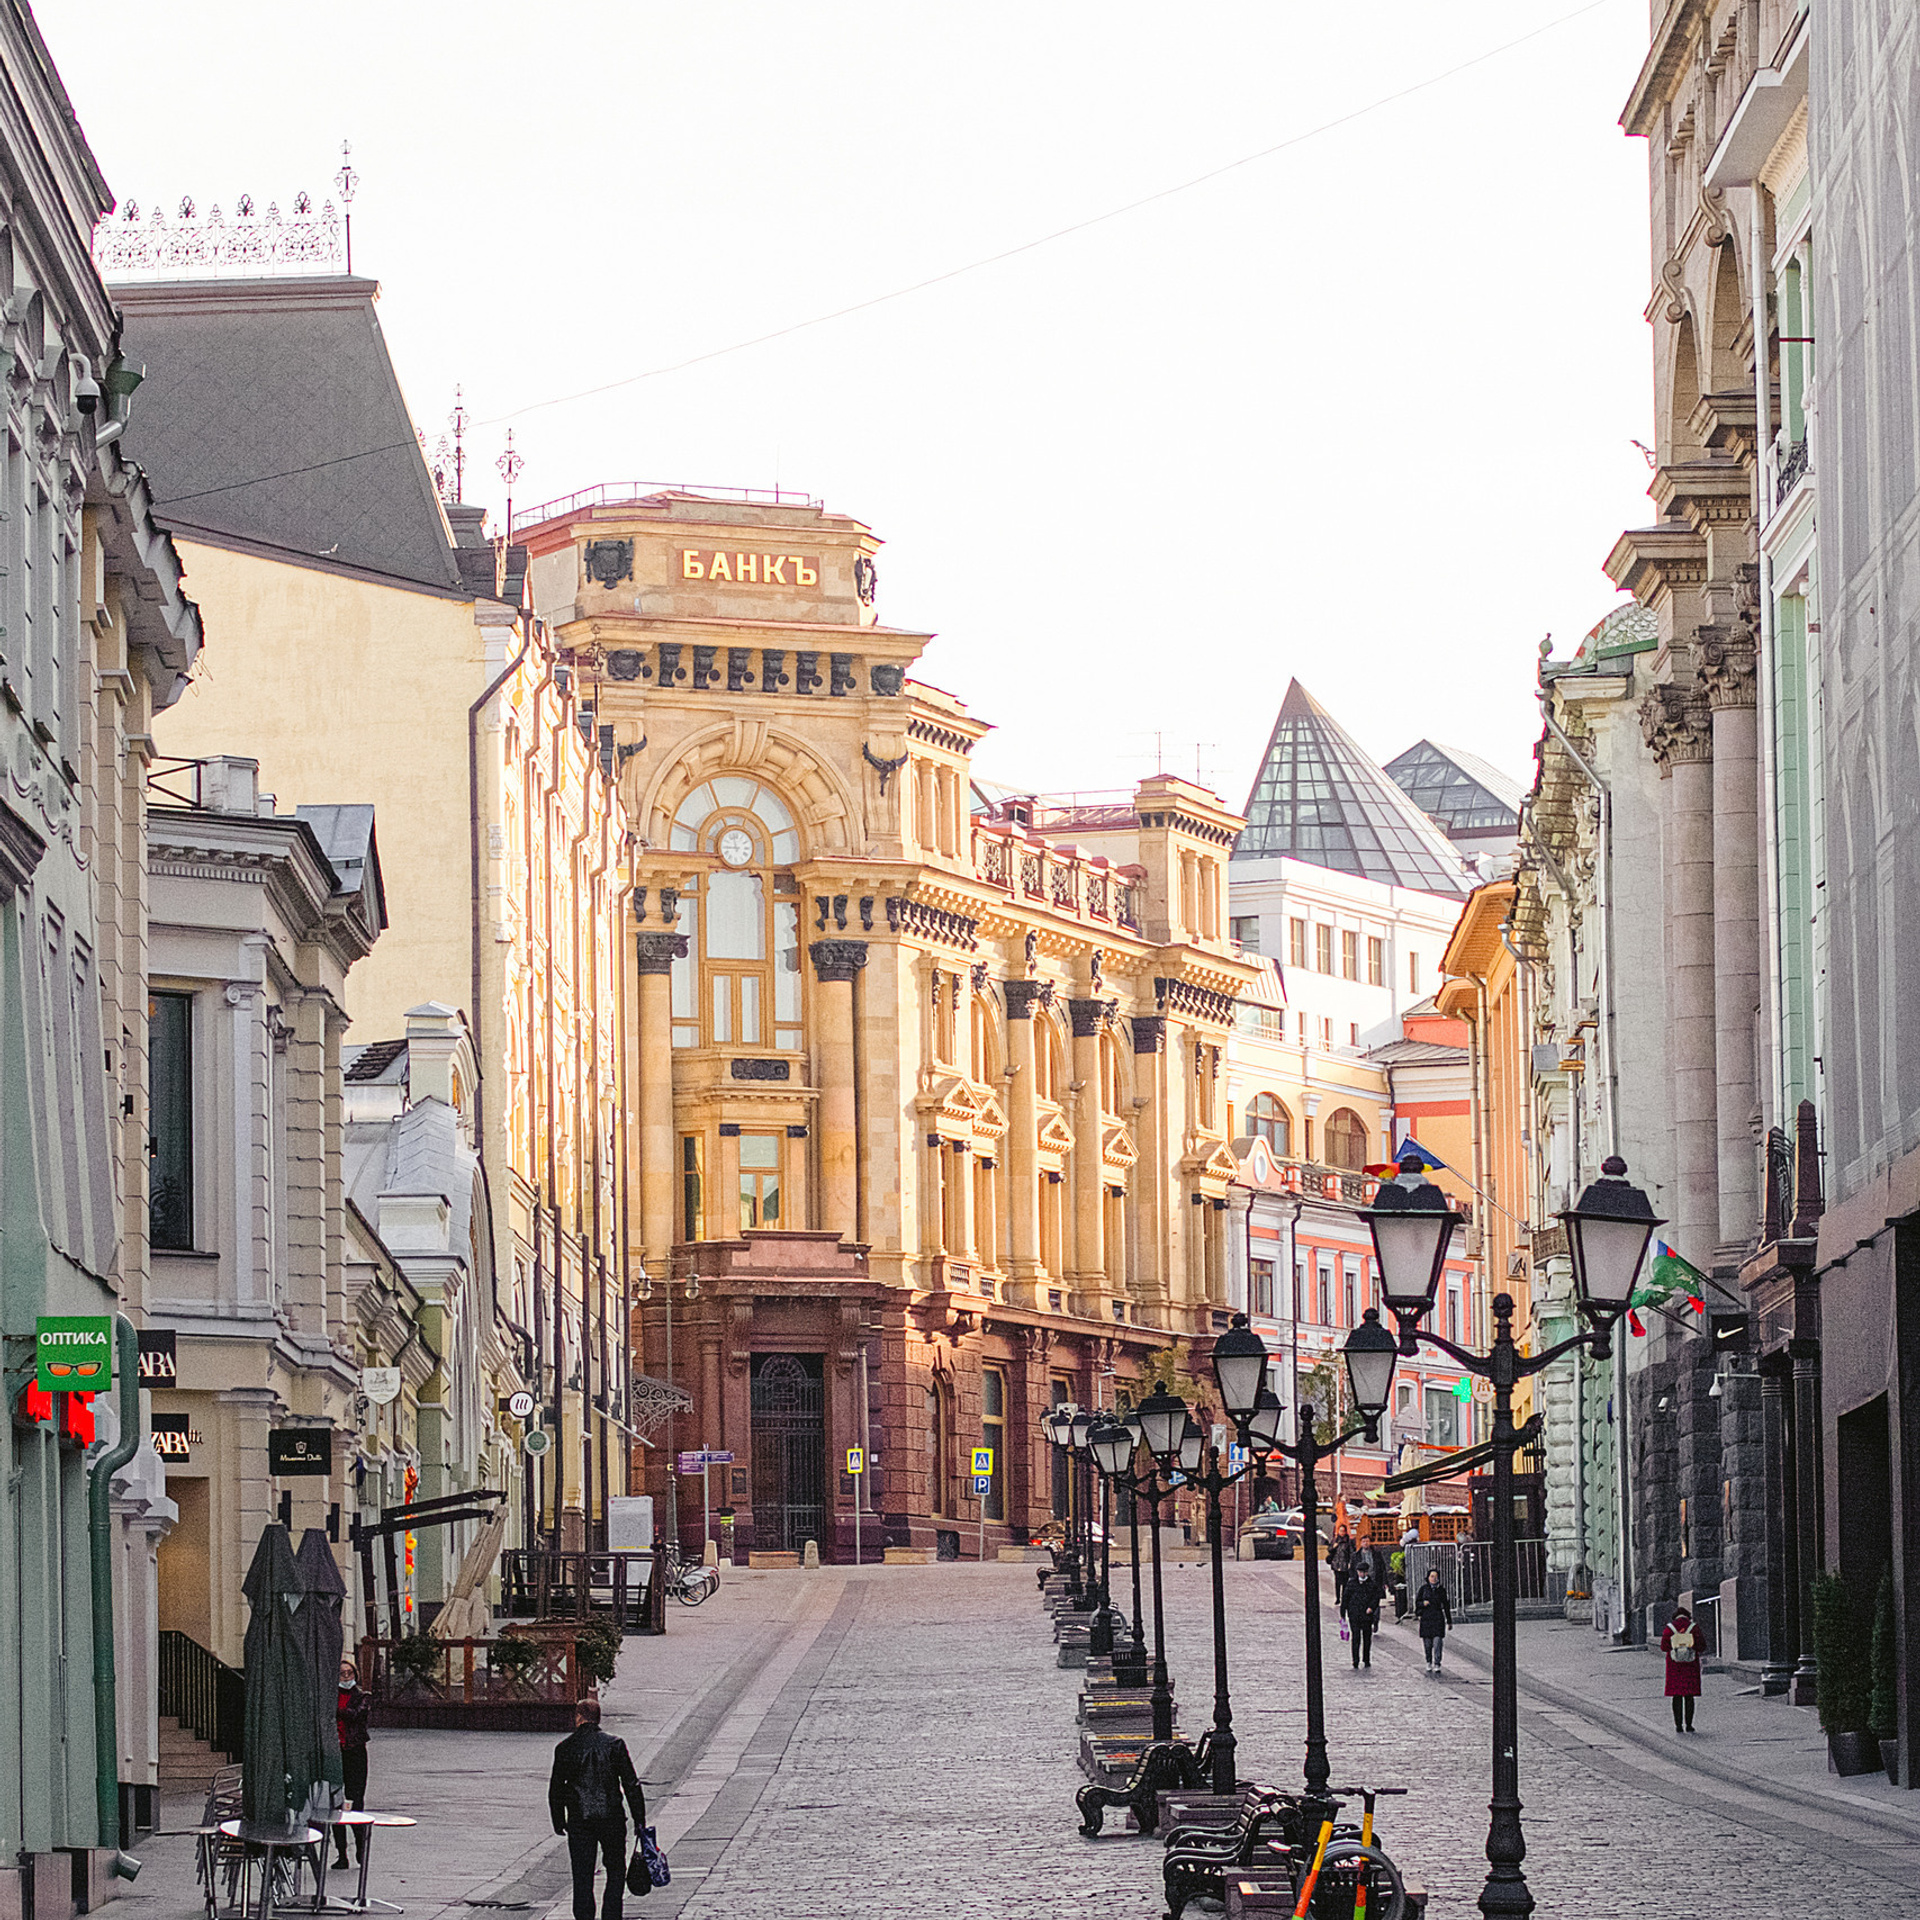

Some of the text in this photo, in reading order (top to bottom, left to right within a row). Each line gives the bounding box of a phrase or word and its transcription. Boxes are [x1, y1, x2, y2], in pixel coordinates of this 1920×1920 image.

[683, 549, 817, 586] БАНКЪ
[40, 1332, 107, 1345] ОПТИКА
[137, 1352, 176, 1377] ARA
[978, 1479, 987, 1491] P
